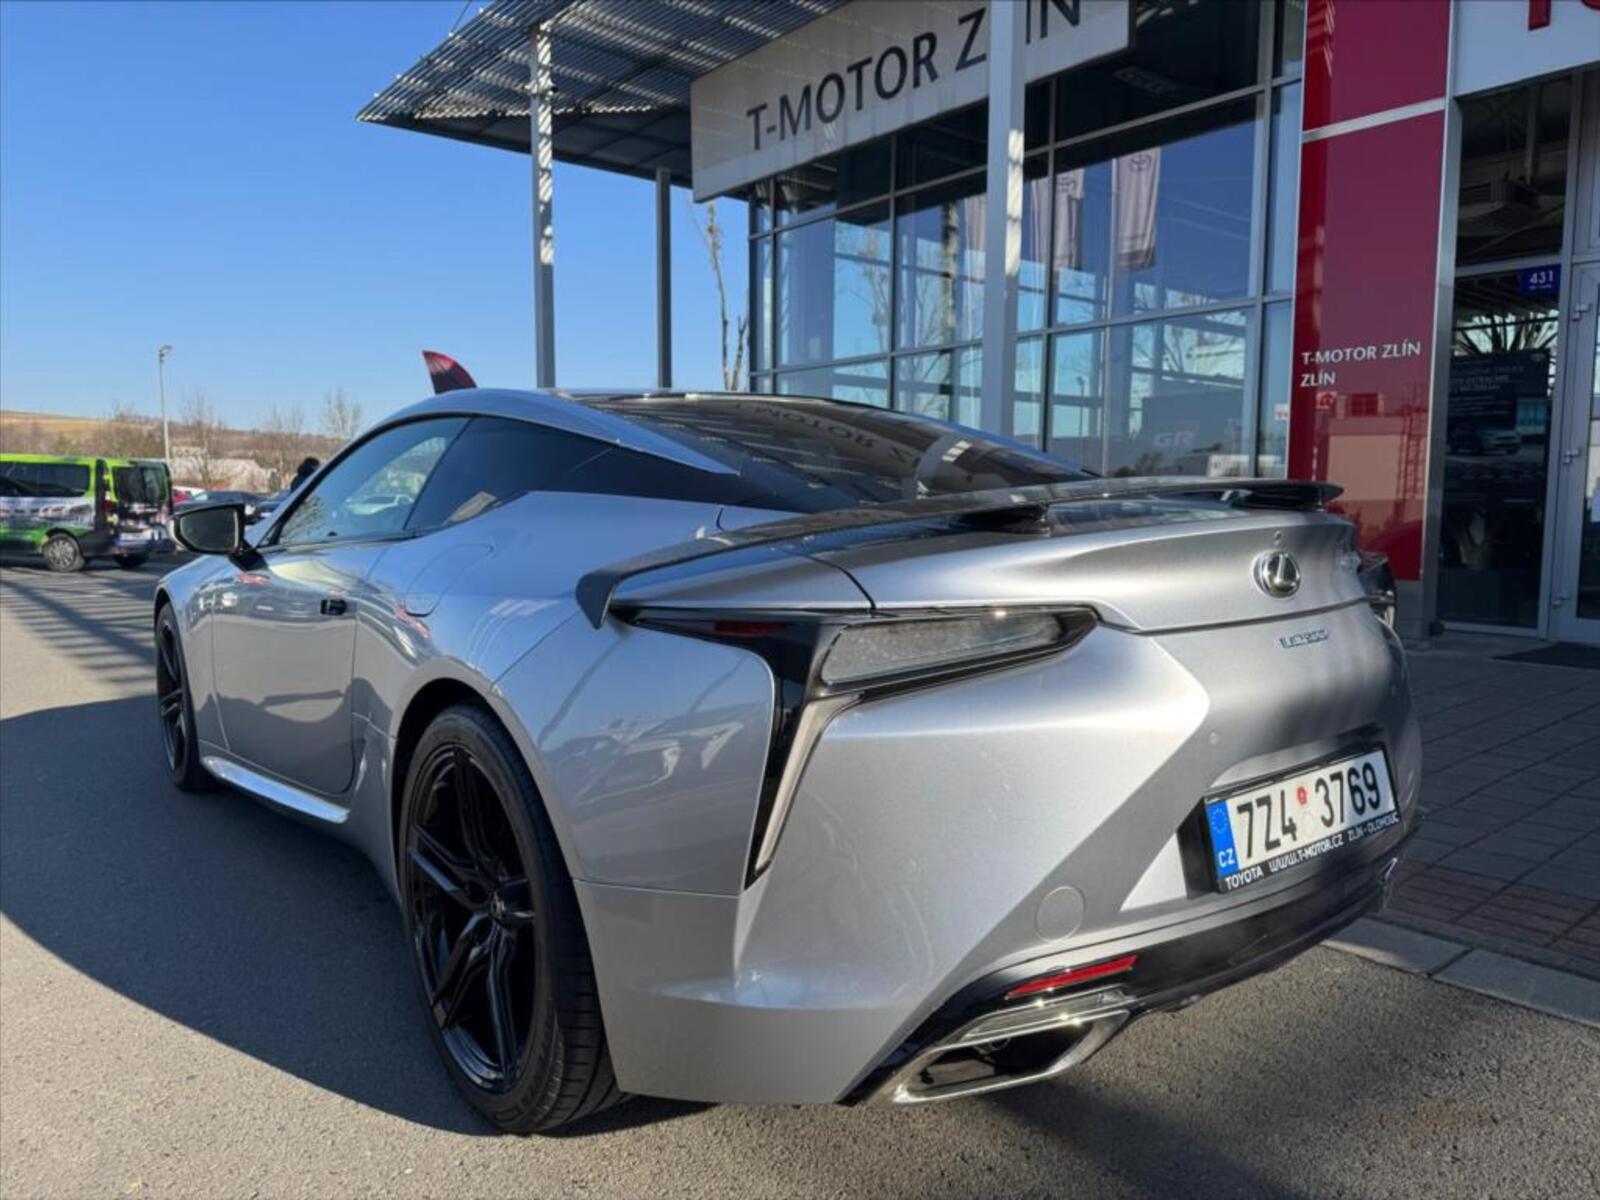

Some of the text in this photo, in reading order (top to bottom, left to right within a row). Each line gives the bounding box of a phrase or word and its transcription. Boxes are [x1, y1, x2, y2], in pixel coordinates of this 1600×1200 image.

[746, 31, 938, 151] T-MOTOR
[1302, 338, 1421, 365] T-MOTOR ZLÍN
[1300, 369, 1336, 387] ZLÍN
[1237, 761, 1381, 859] 7Z4 3769
[1218, 848, 1236, 868] CZ
[1225, 865, 1264, 891] TOYOTA
